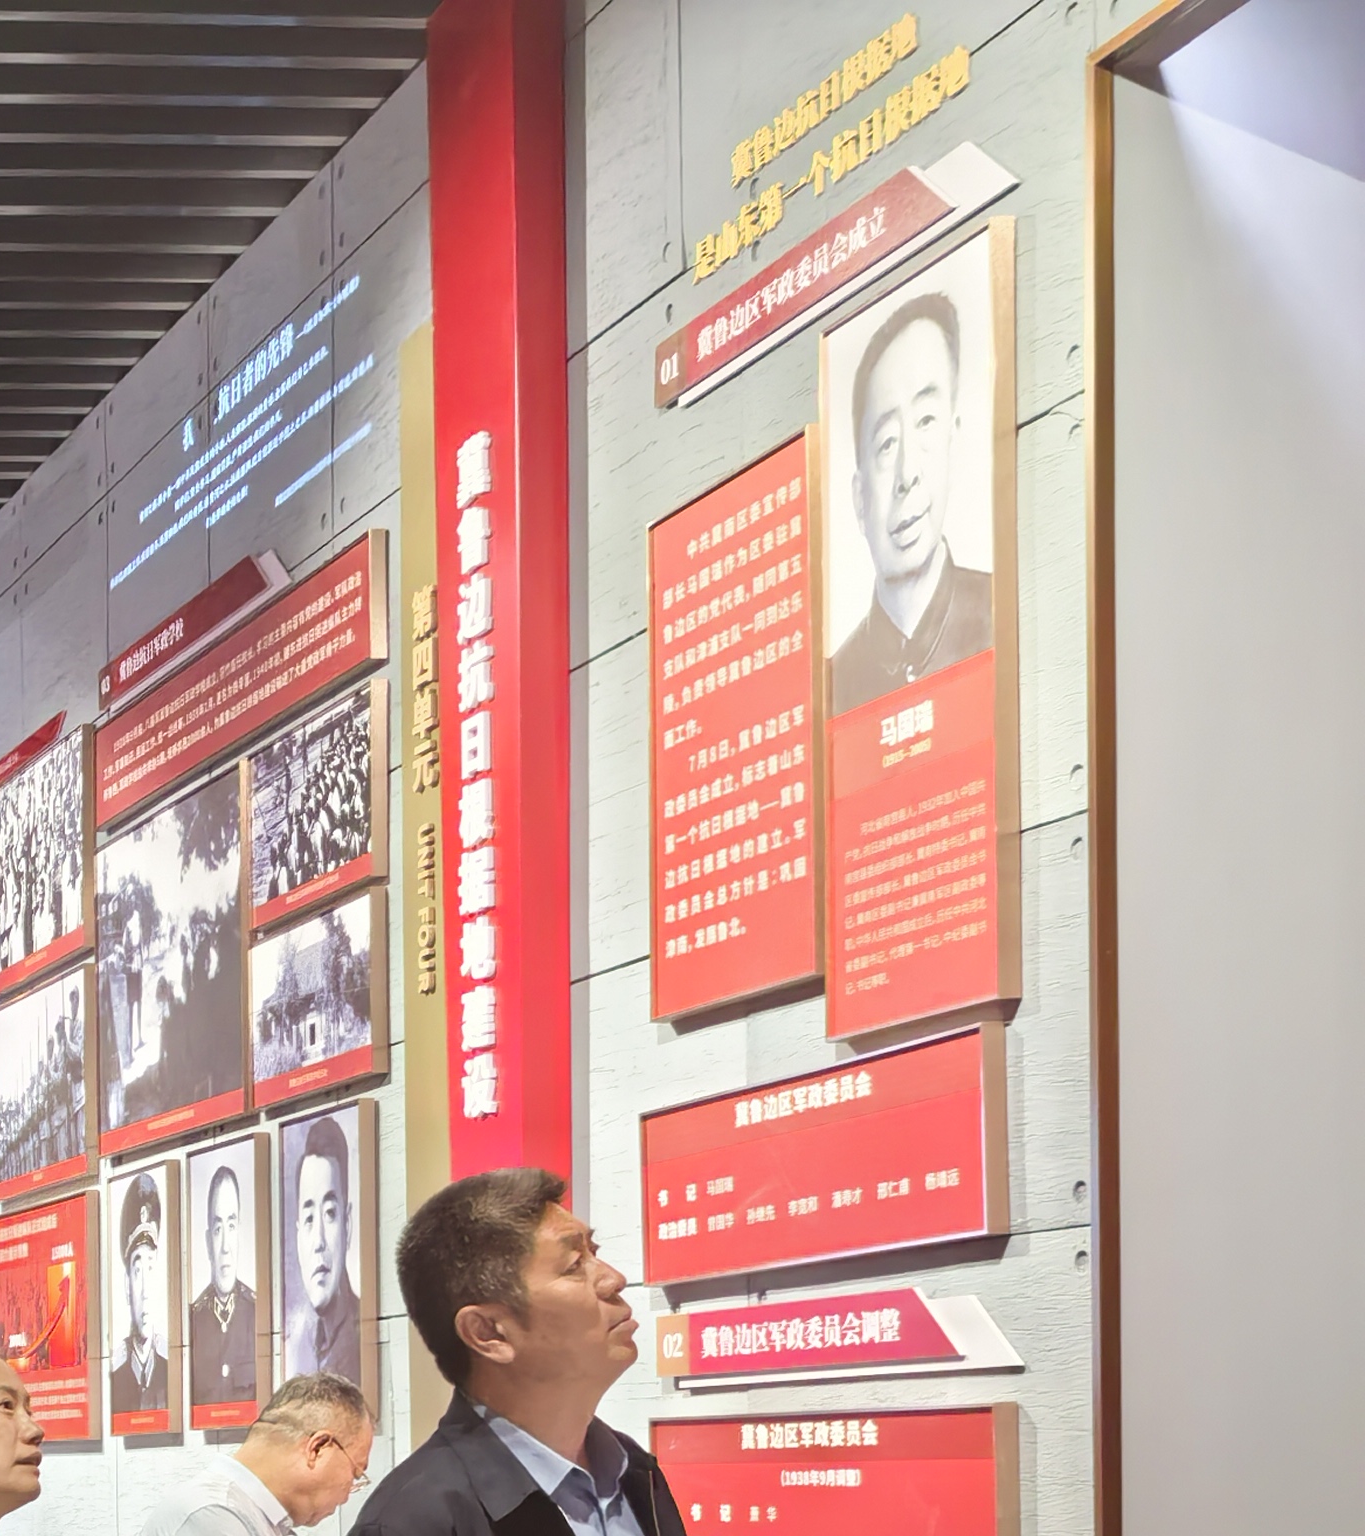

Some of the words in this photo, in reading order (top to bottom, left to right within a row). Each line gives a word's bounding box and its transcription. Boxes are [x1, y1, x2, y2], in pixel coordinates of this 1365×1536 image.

[731, 12, 918, 188] 冀鲁边抗日根据地
[692, 45, 971, 285] 是山东第一个抗日根据地
[660, 353, 680, 386] 01
[697, 206, 887, 361] 冀鲁边区军政委员会成立
[411, 584, 439, 793] 第四单元
[879, 700, 934, 746] 马国瑞
[457, 430, 499, 1120] 冀鲁边抗日根据地建设
[417, 822, 436, 901] UNIT
[418, 906, 437, 998] FOUR
[735, 1071, 872, 1128] 冀鲁边区军政委员会
[658, 1217, 698, 1241] 政治委员
[925, 1168, 960, 1191] 杨靖远
[706, 1176, 735, 1196] 马国瑞
[662, 1332, 683, 1359] 02
[701, 1308, 901, 1359] 冀鲁边区军政委员会调整
[741, 1419, 879, 1450] 冀鲁边区军政委员会
